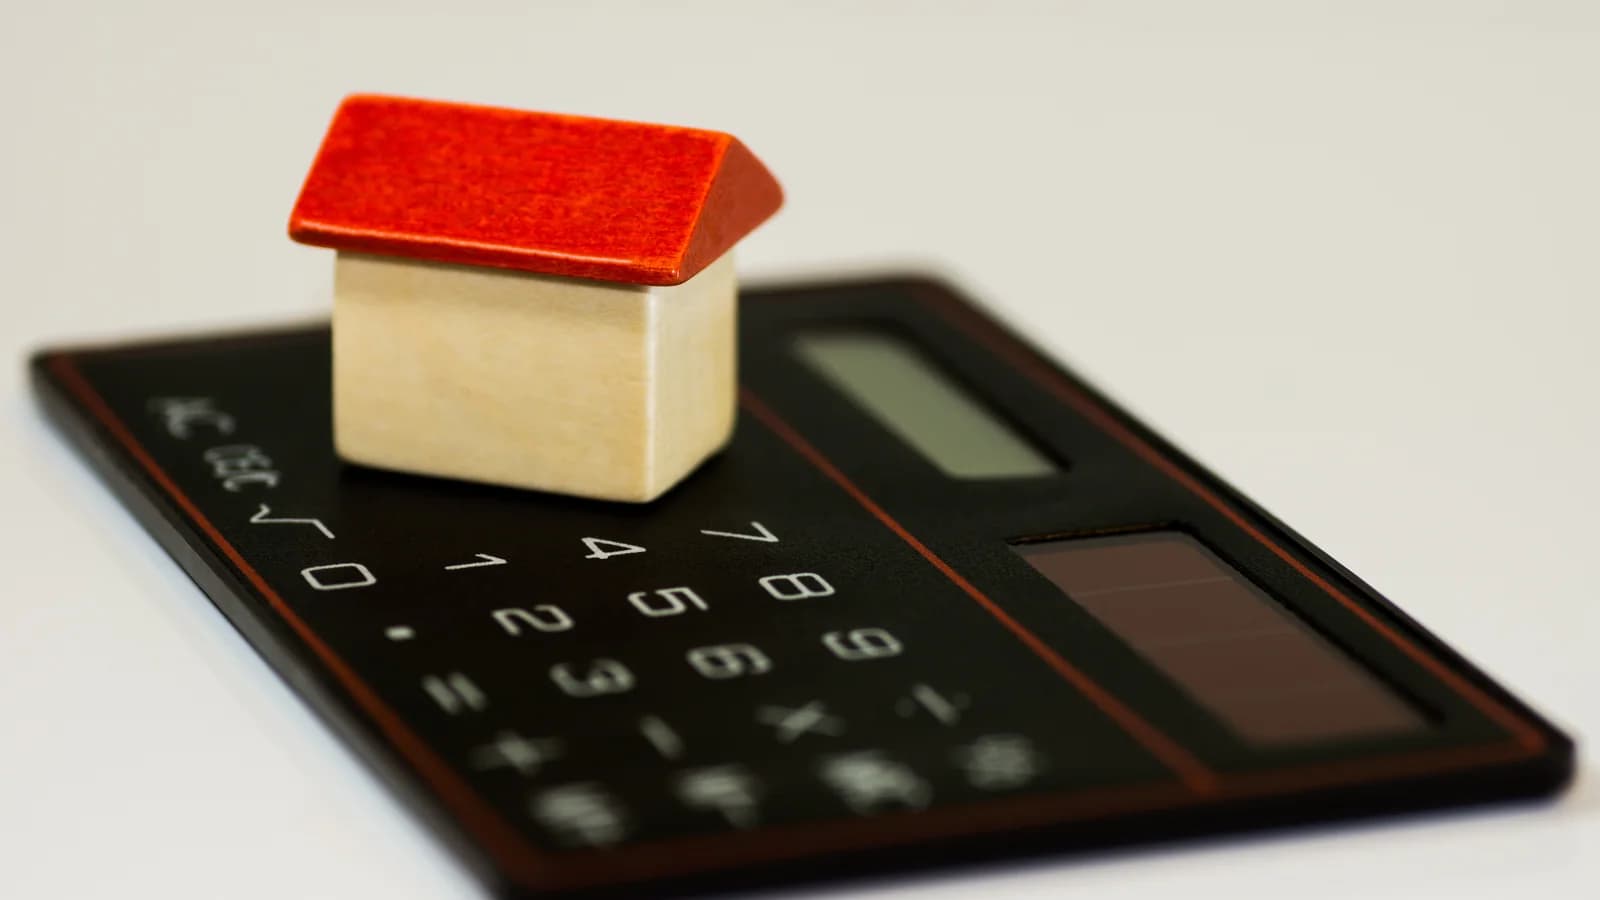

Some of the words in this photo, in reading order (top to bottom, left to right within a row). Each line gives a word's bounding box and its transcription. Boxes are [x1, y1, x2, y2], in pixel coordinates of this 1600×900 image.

[701, 522, 779, 542] 7
[445, 554, 507, 570] 1
[582, 537, 646, 559] 4
[301, 563, 376, 590] 0
[759, 573, 835, 600] 8
[628, 587, 707, 616] 5
[493, 605, 573, 634] 2
[823, 629, 902, 659] 9
[688, 645, 770, 677] 6
[552, 662, 633, 694] 3
